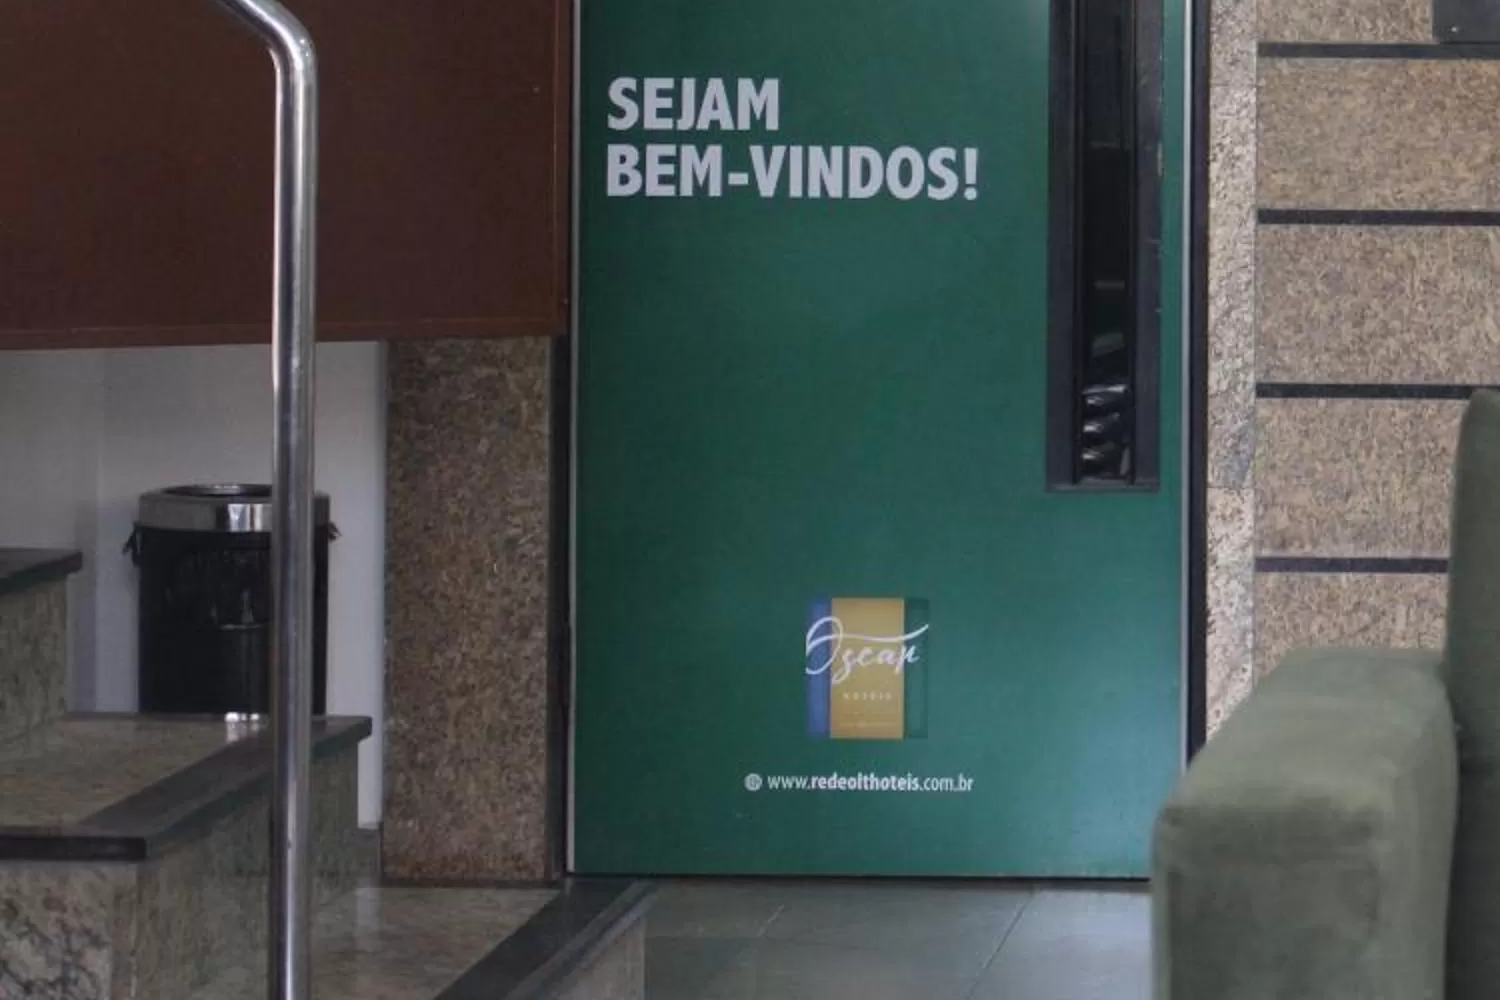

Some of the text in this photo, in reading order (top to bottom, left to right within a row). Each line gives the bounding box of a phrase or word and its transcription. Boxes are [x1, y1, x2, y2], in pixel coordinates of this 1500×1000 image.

[608, 77, 780, 131] SEJAM
[606, 147, 979, 202] BEM-VINDOS!
[768, 772, 974, 792] www.redeolthoteis.com.br
